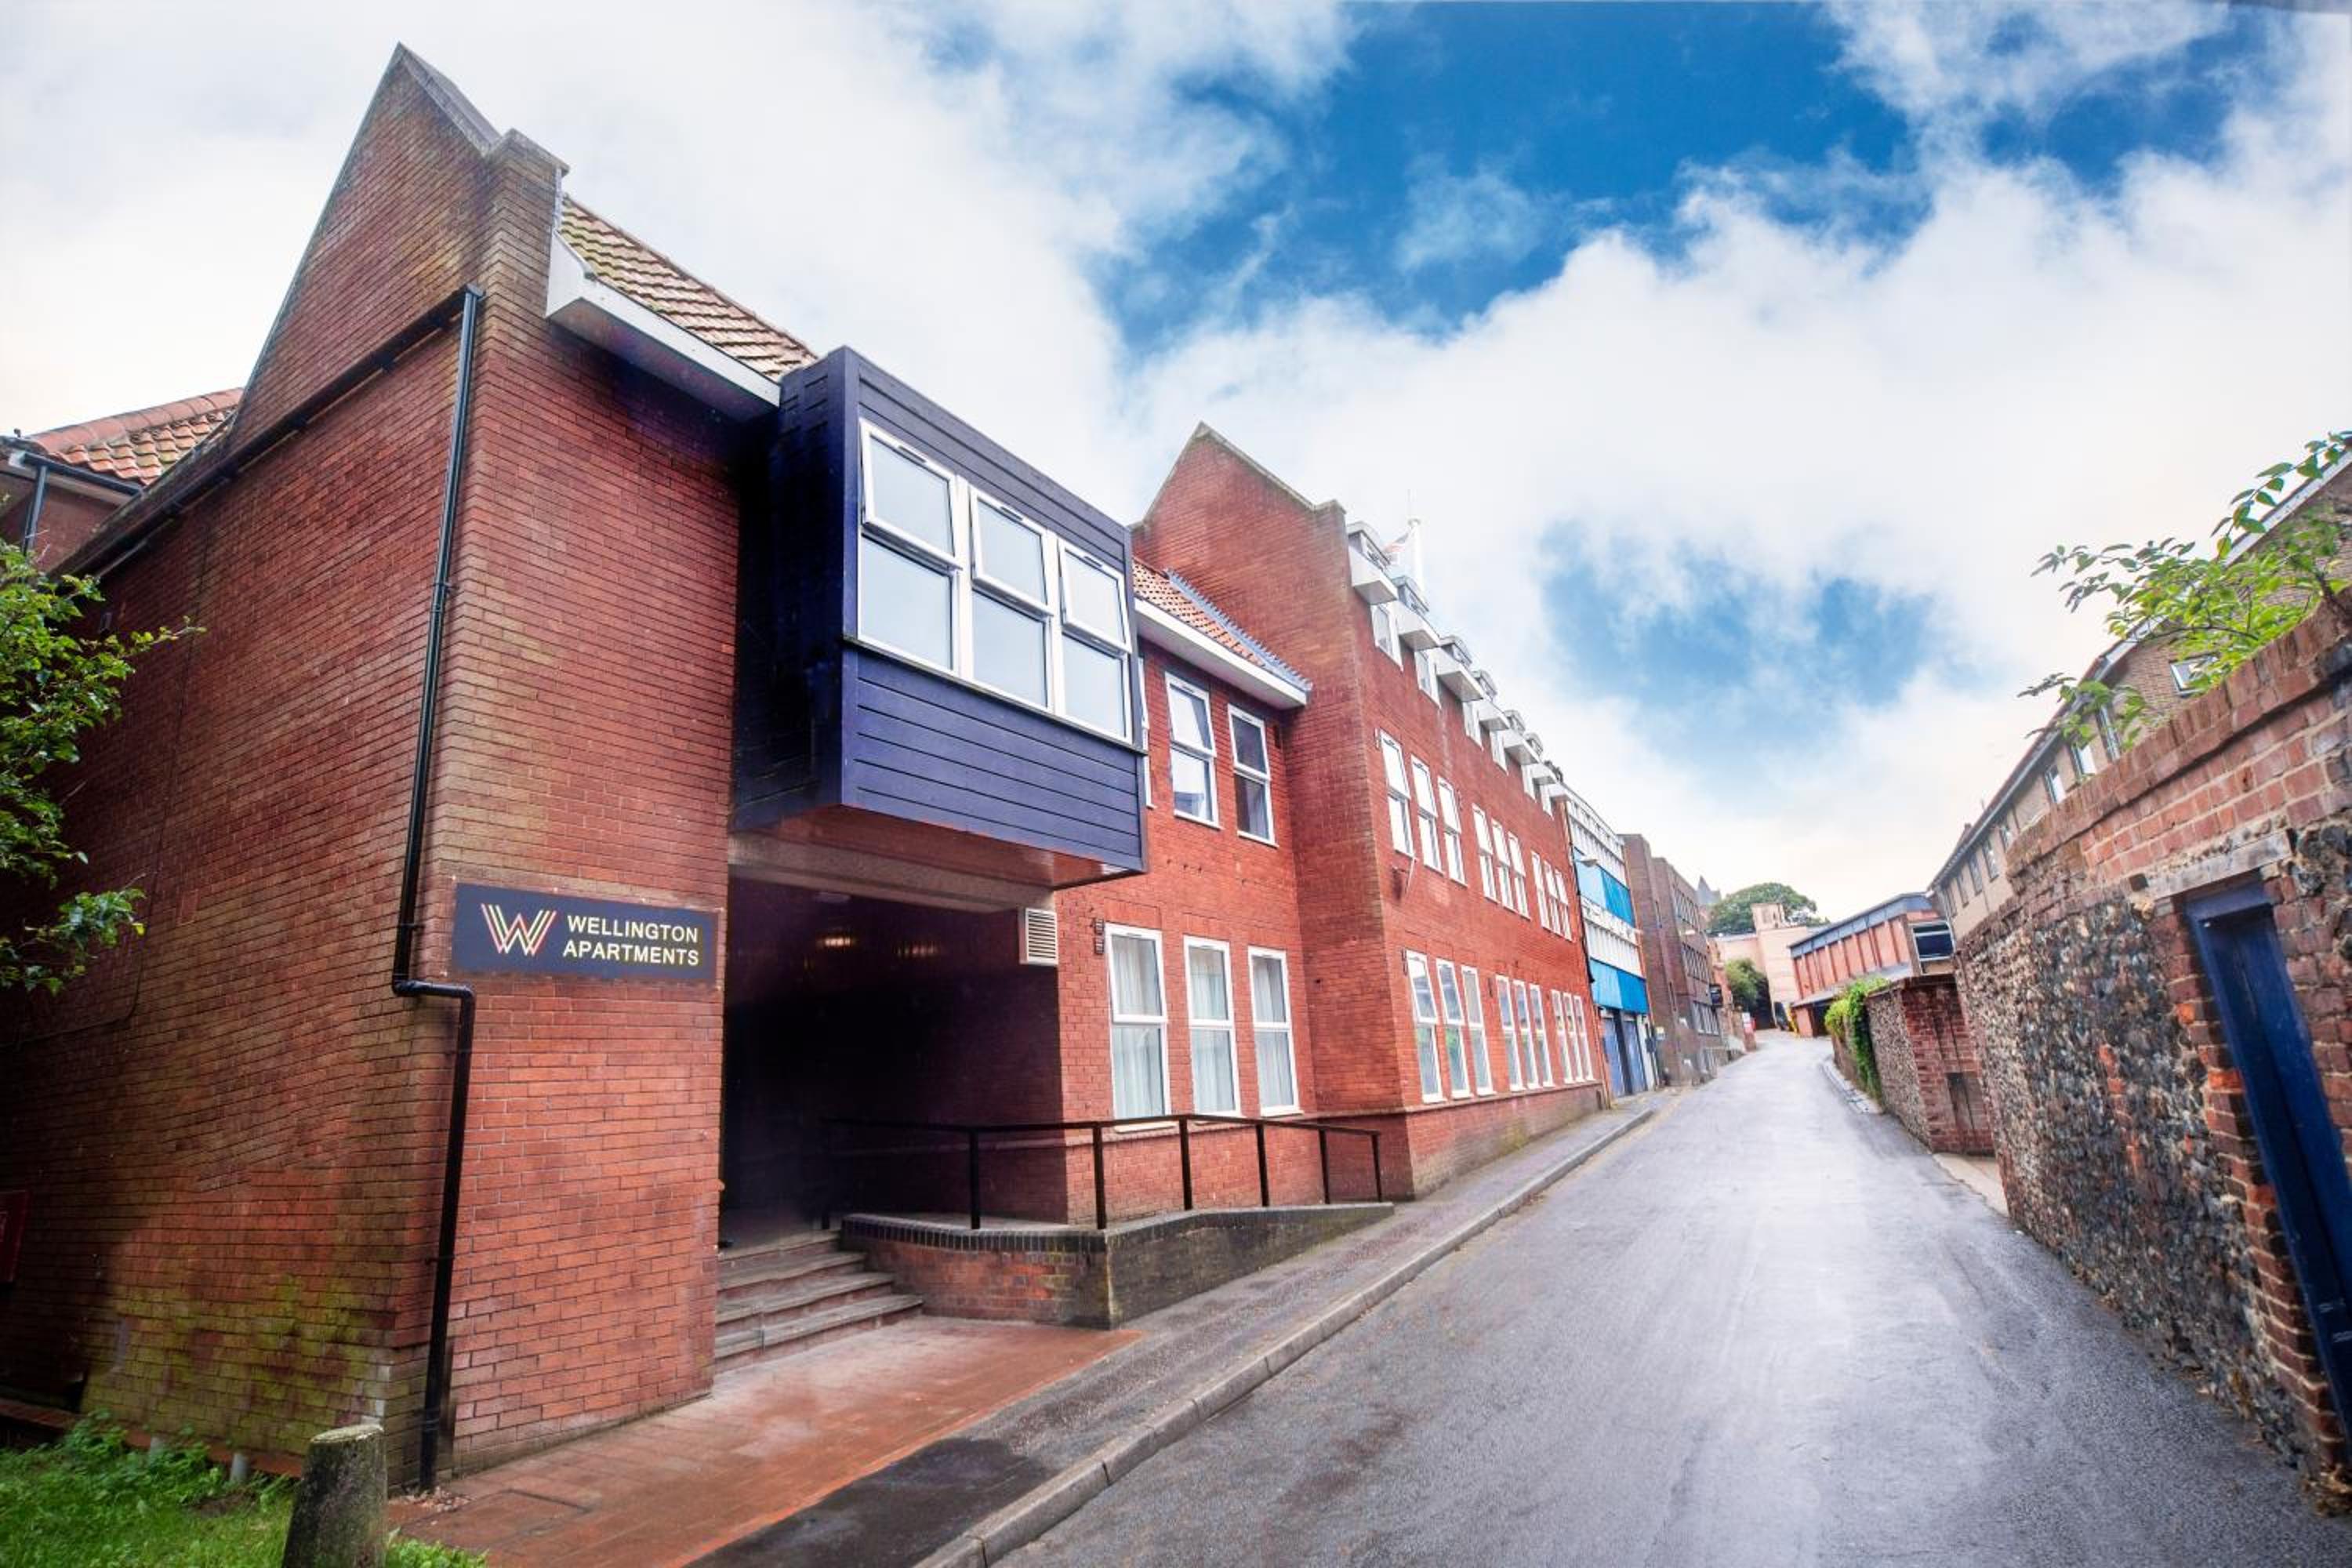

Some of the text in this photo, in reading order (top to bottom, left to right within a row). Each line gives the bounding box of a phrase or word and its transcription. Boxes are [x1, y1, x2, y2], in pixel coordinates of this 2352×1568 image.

[481, 903, 557, 956] W
[568, 915, 699, 943] WELLINGTON
[563, 940, 699, 966] APARTMENTS
